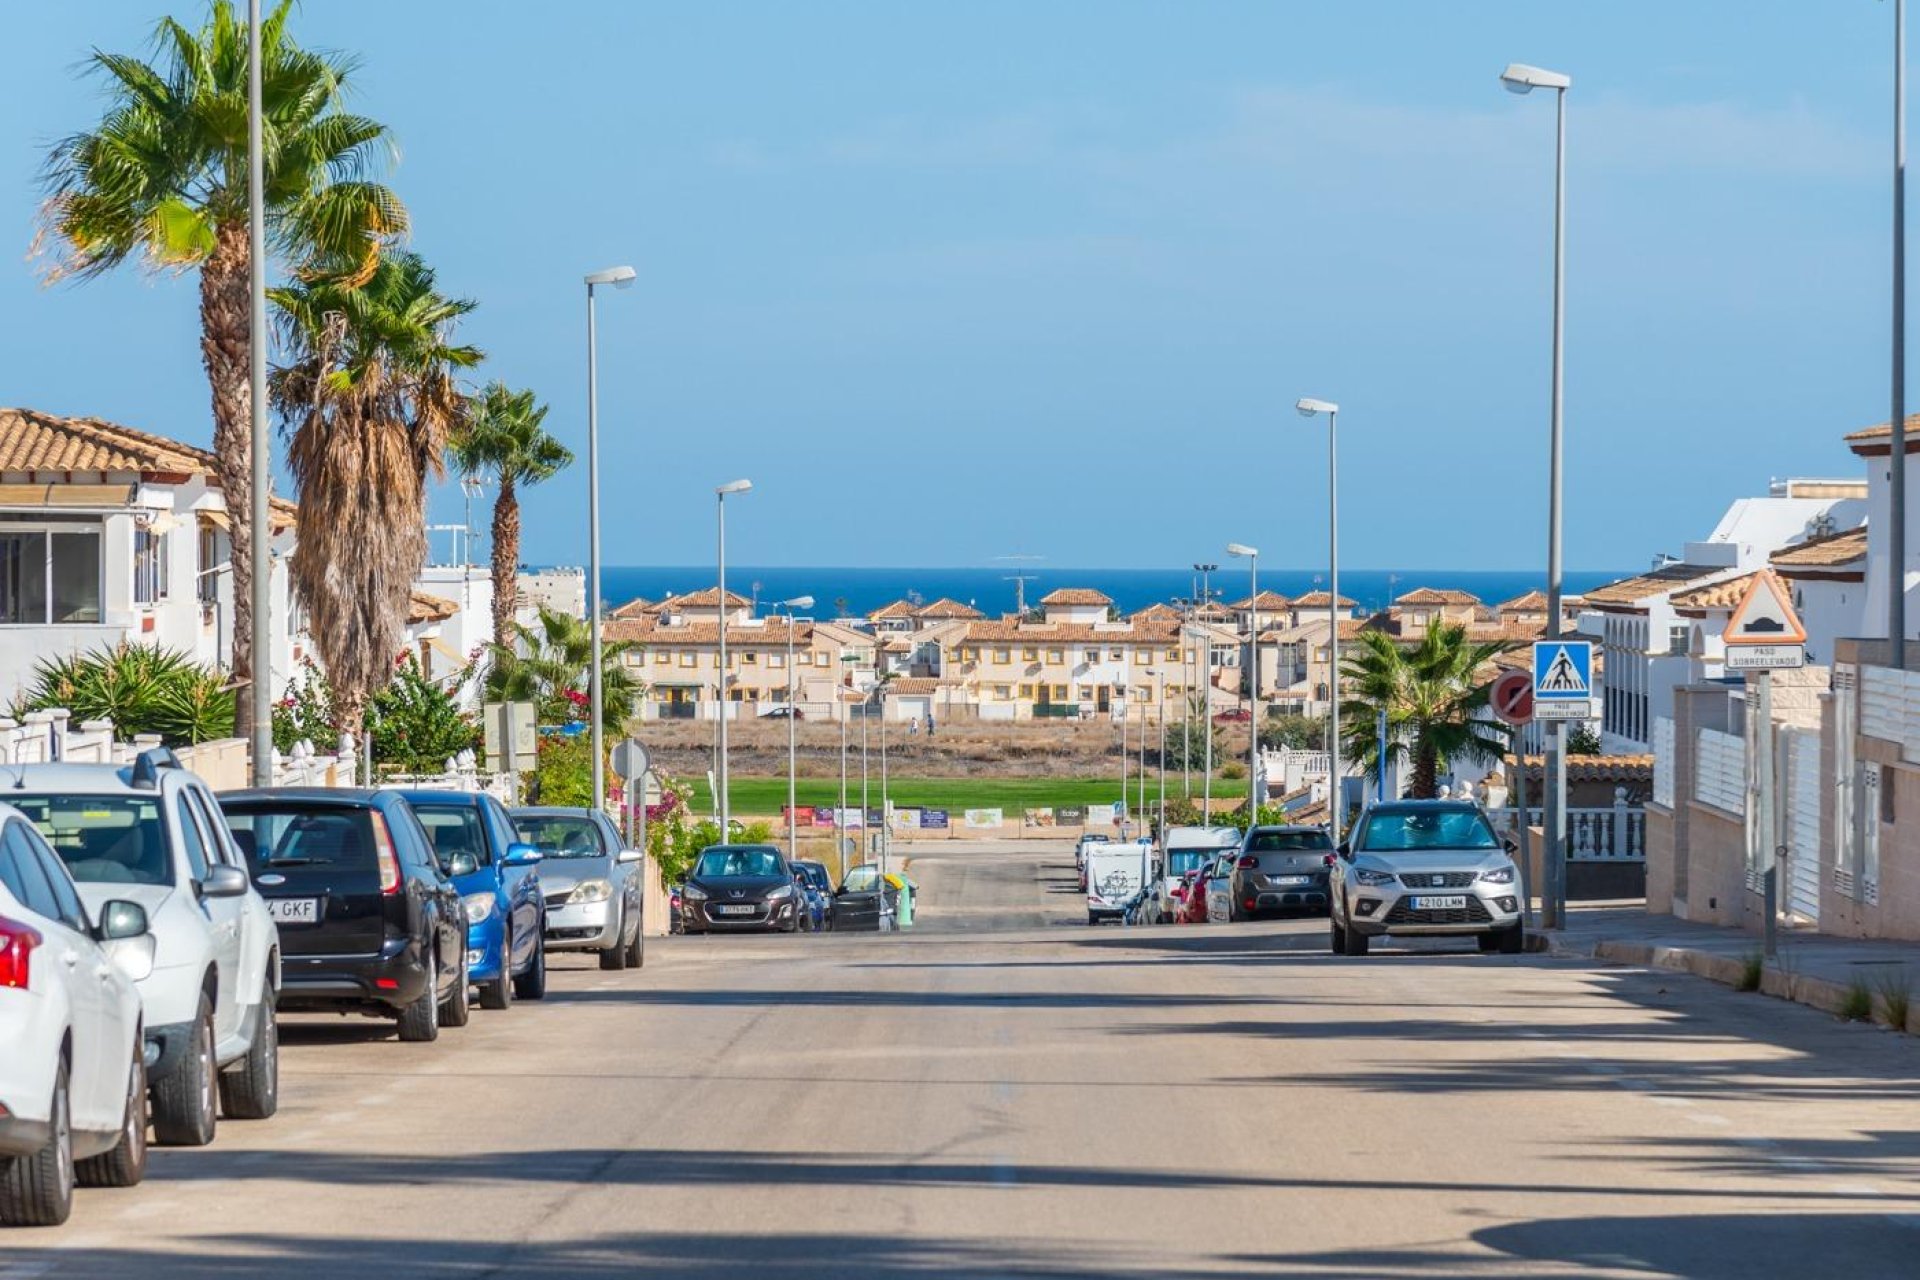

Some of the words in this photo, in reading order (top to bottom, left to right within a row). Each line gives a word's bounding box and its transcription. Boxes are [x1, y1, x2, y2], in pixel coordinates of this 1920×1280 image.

[1733, 657, 1796, 666] SOBREELEVADO
[1418, 897, 1442, 908] 4210
[1444, 897, 1464, 908] LMM
[282, 901, 313, 916] GKF
